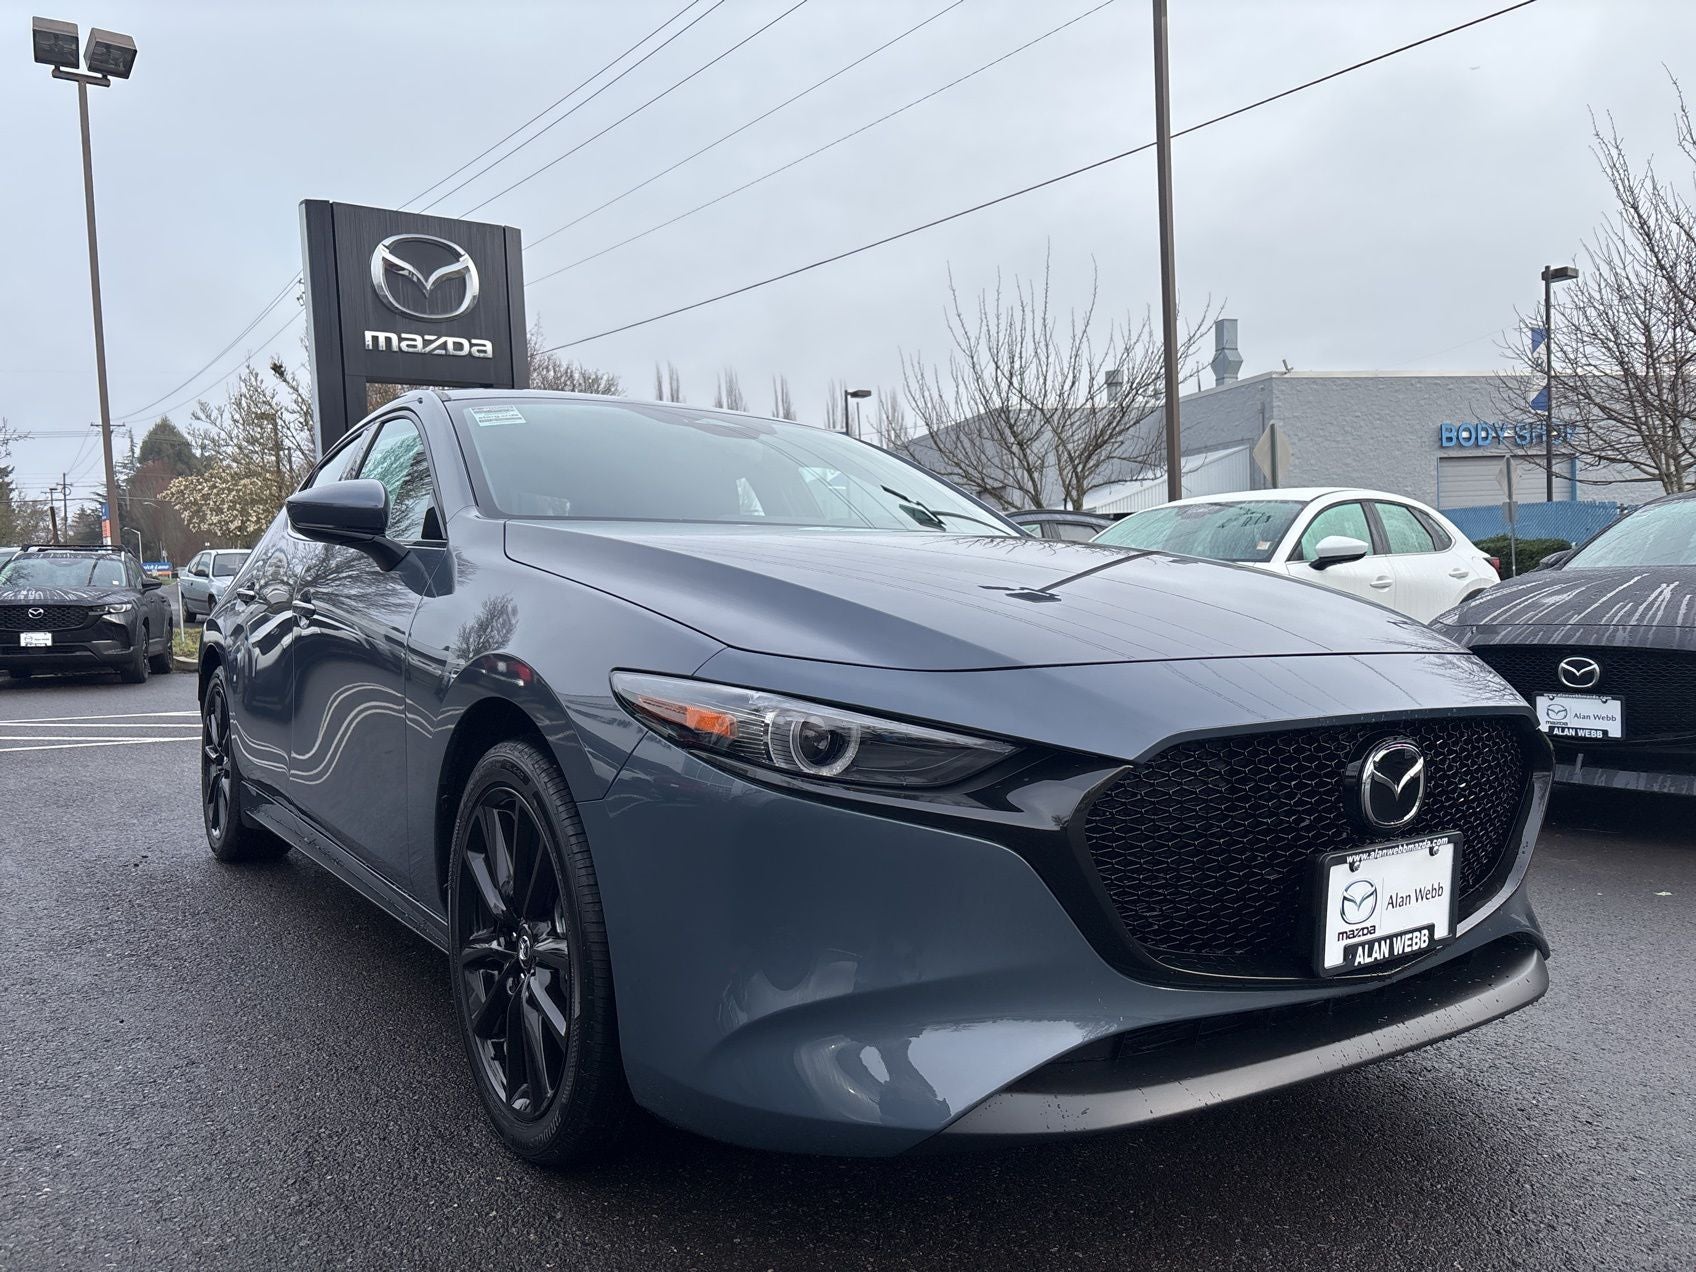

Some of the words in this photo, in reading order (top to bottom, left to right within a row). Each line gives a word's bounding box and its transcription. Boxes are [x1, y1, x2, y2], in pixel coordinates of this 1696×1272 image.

[364, 330, 493, 359] mazda
[1440, 422, 1507, 448] BODY
[1573, 712, 1591, 720] Alan
[1593, 713, 1617, 722] Webb
[1553, 727, 1576, 736] ALAN
[1577, 729, 1603, 738] WEBB
[1346, 837, 1449, 863] www.alanwebbmazda.com
[1386, 892, 1412, 911] Alan
[1414, 881, 1444, 903] Webb
[1337, 924, 1376, 942] mazda
[1354, 938, 1390, 967] ALAN
[1392, 929, 1430, 956] WEBB
